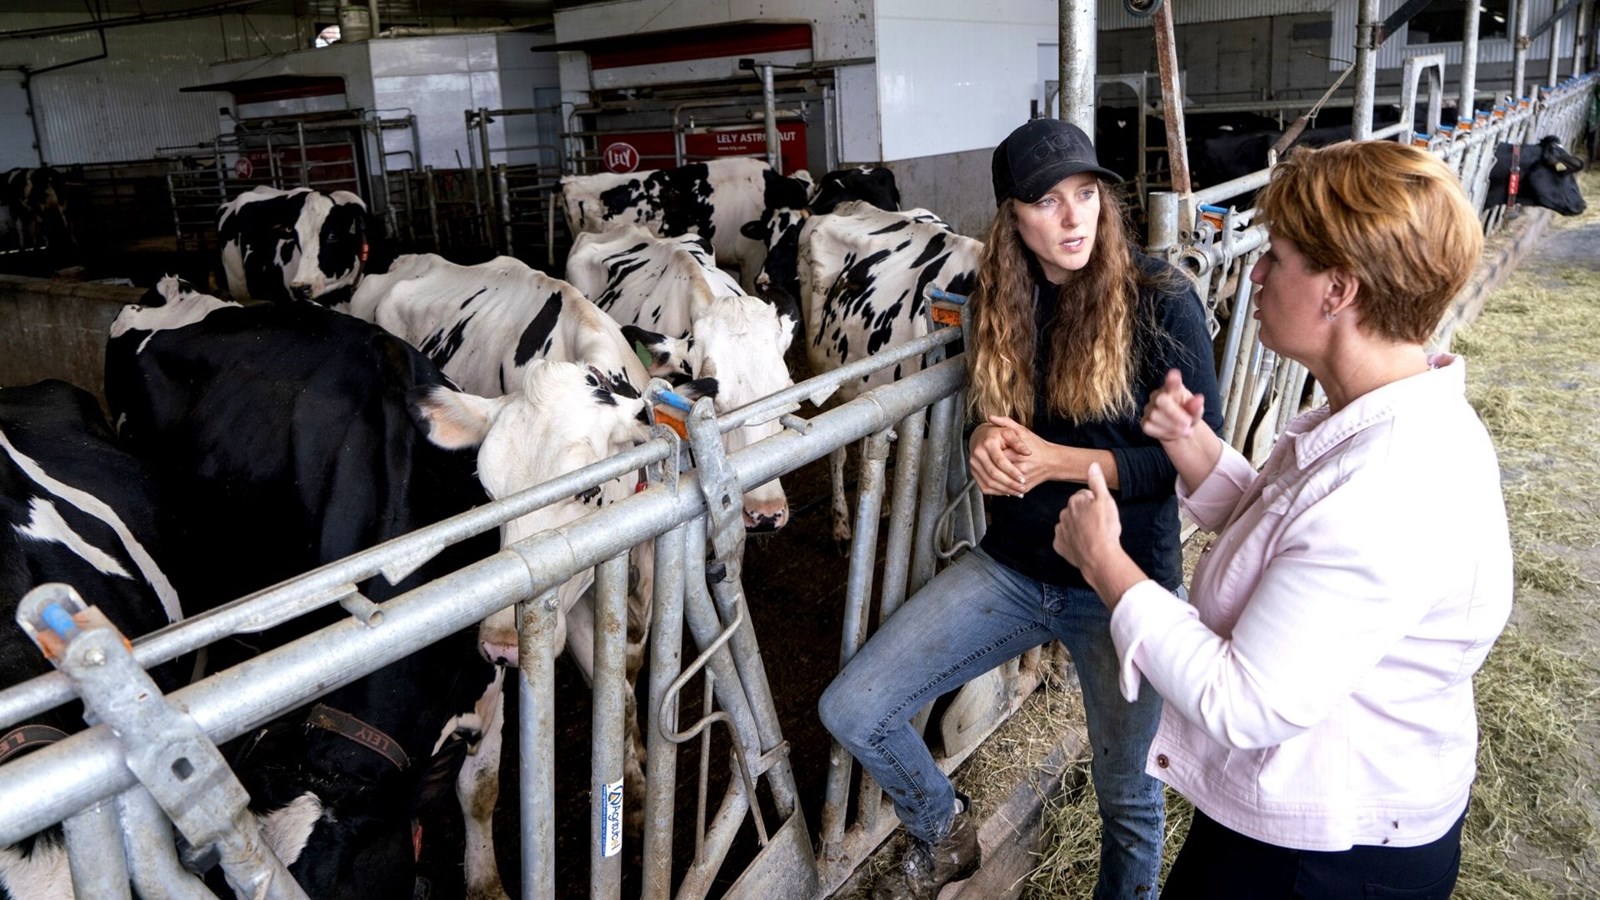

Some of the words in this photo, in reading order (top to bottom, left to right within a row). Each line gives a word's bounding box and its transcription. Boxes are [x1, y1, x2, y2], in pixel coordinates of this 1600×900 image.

[716, 134, 738, 144] LELY
[740, 131, 796, 143] ASTRAUT
[608, 148, 631, 169] LELY
[355, 727, 389, 751] LELY
